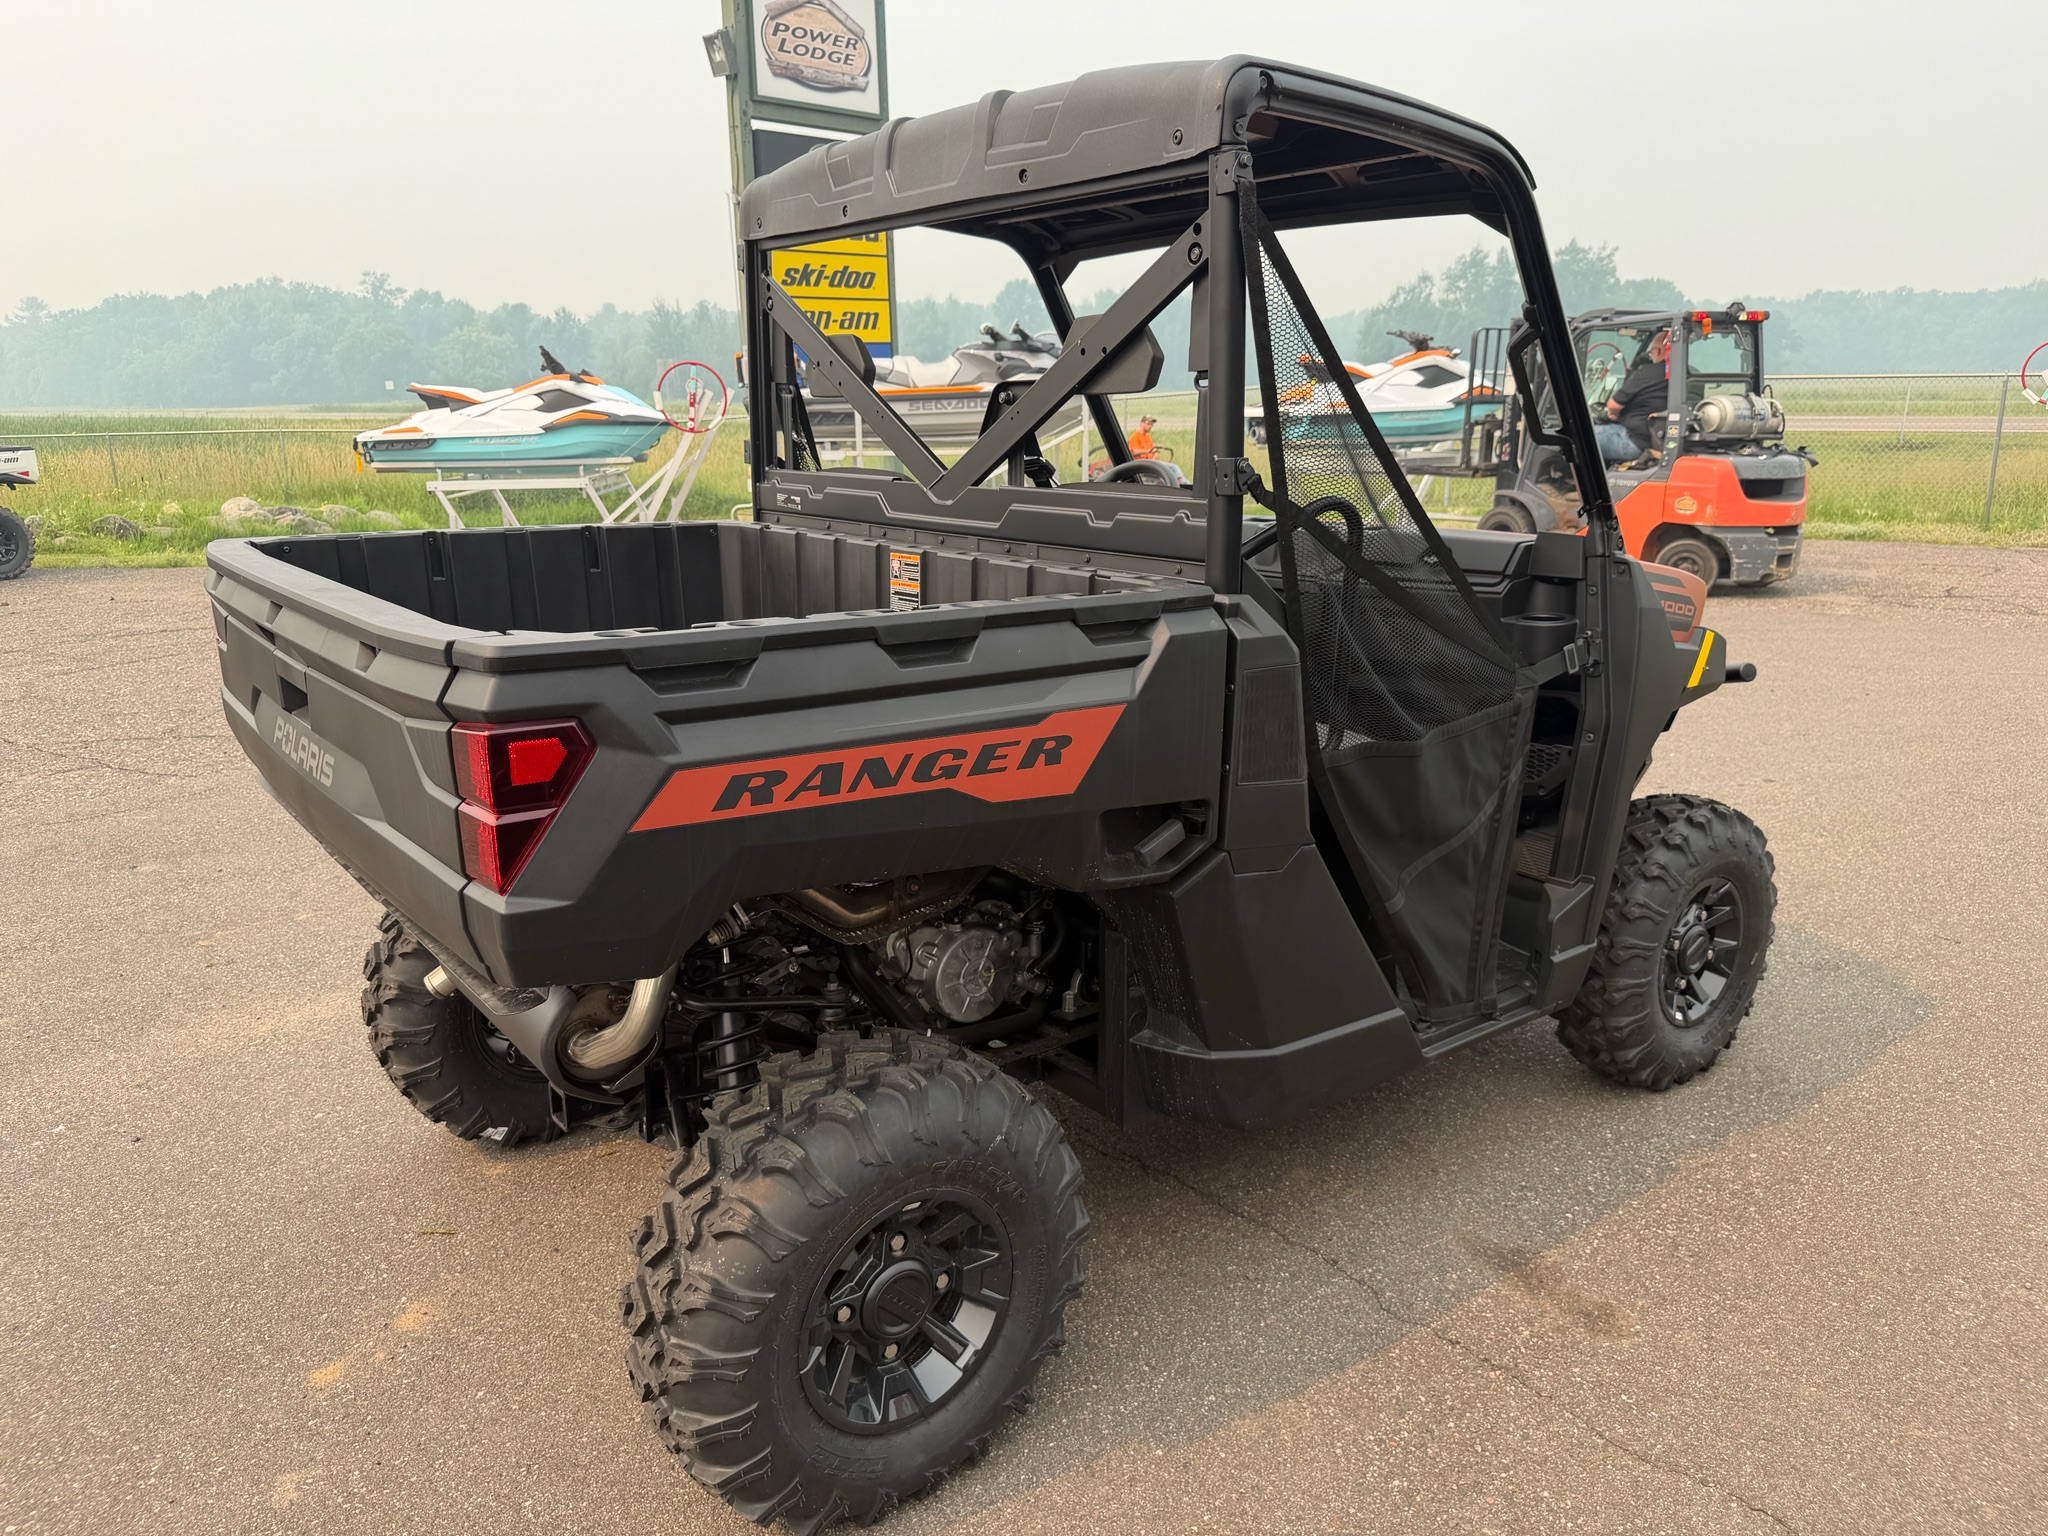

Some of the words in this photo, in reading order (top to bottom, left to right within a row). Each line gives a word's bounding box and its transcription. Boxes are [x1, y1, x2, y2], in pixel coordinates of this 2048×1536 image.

[771, 21, 859, 51] POWER
[777, 37, 857, 67] LODGE
[781, 263, 876, 289] ski-doo
[273, 715, 335, 788] POLARIS
[711, 735, 1073, 812] RANGER
